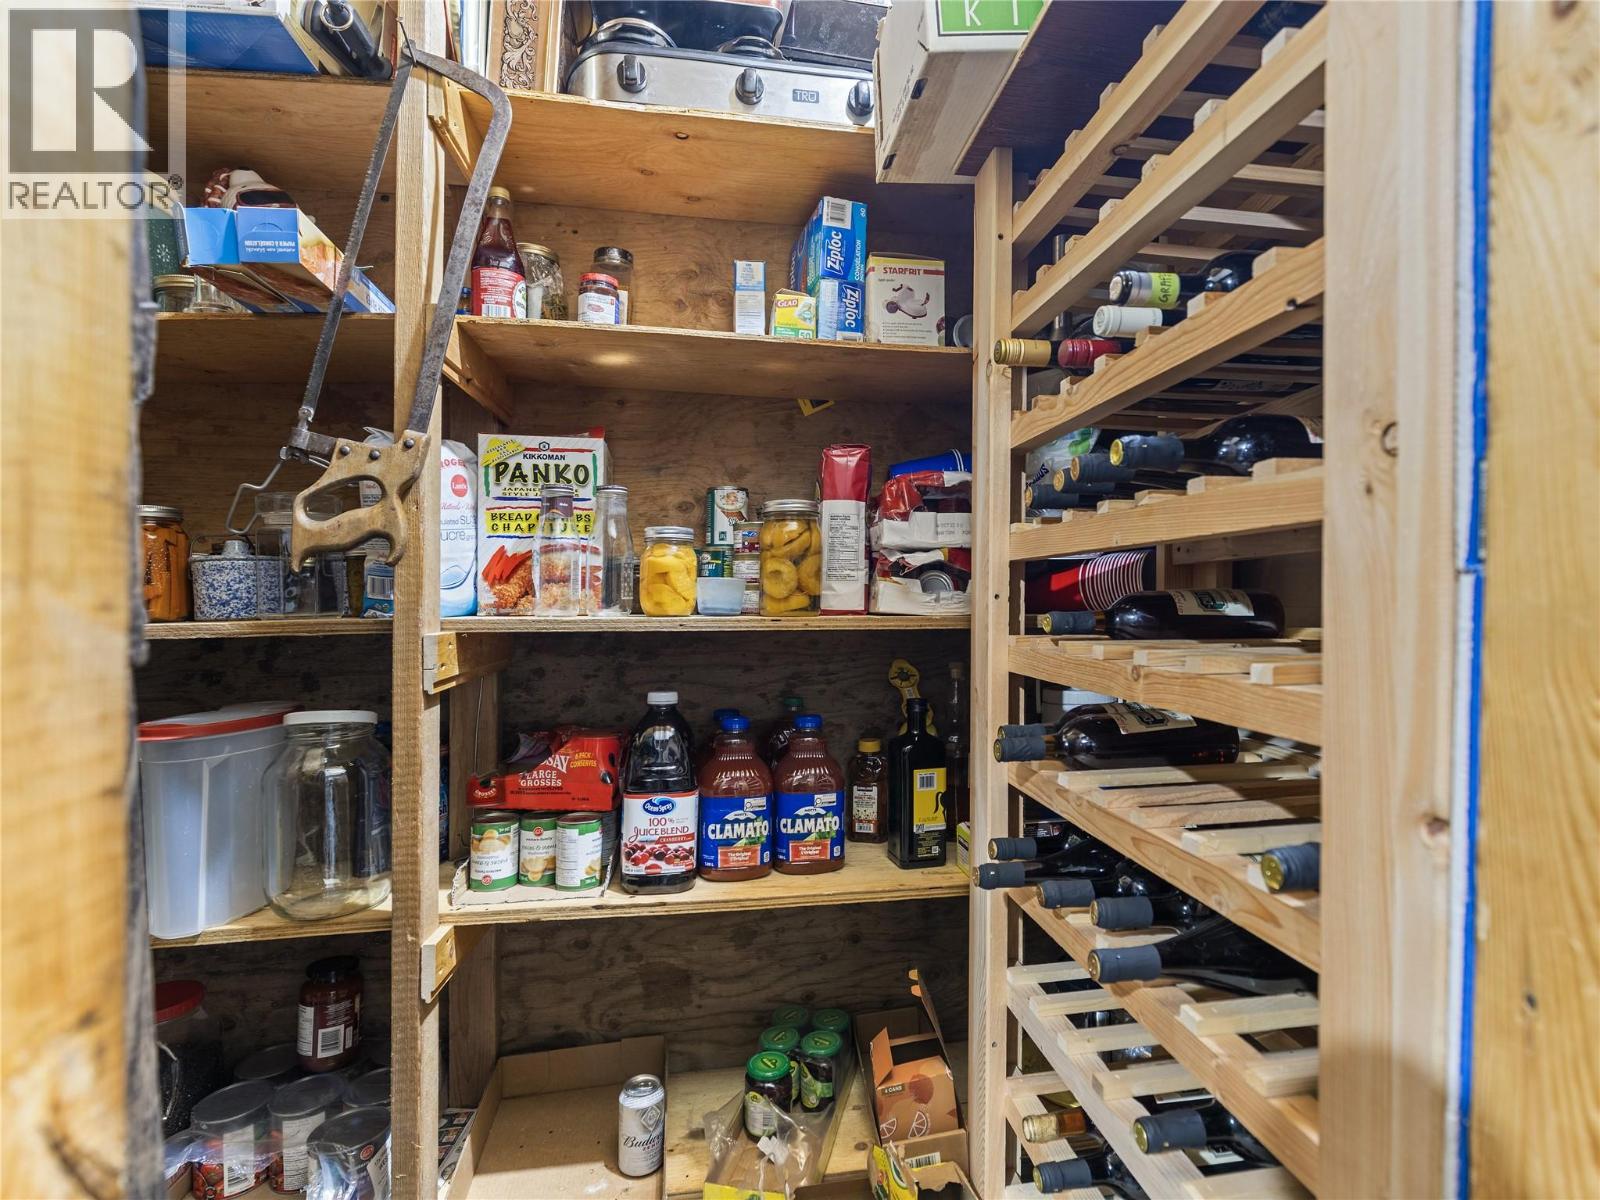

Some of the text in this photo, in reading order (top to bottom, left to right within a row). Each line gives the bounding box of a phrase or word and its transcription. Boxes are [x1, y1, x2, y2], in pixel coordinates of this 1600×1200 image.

[827, 231, 844, 272] Ziploc
[883, 267, 923, 276] STARFRIT
[777, 299, 798, 307] GLAD
[843, 288, 860, 328] Ziploc
[523, 453, 566, 461] KIKKOMAN
[495, 461, 590, 485] PANKO
[490, 512, 533, 521] BREAD
[520, 779, 562, 787] GROSSES
[645, 803, 673, 813] Ocean Spray
[707, 820, 769, 840] CLAMATO
[780, 816, 840, 834] CLAMATO
[628, 826, 689, 843] JUICE BLEND
